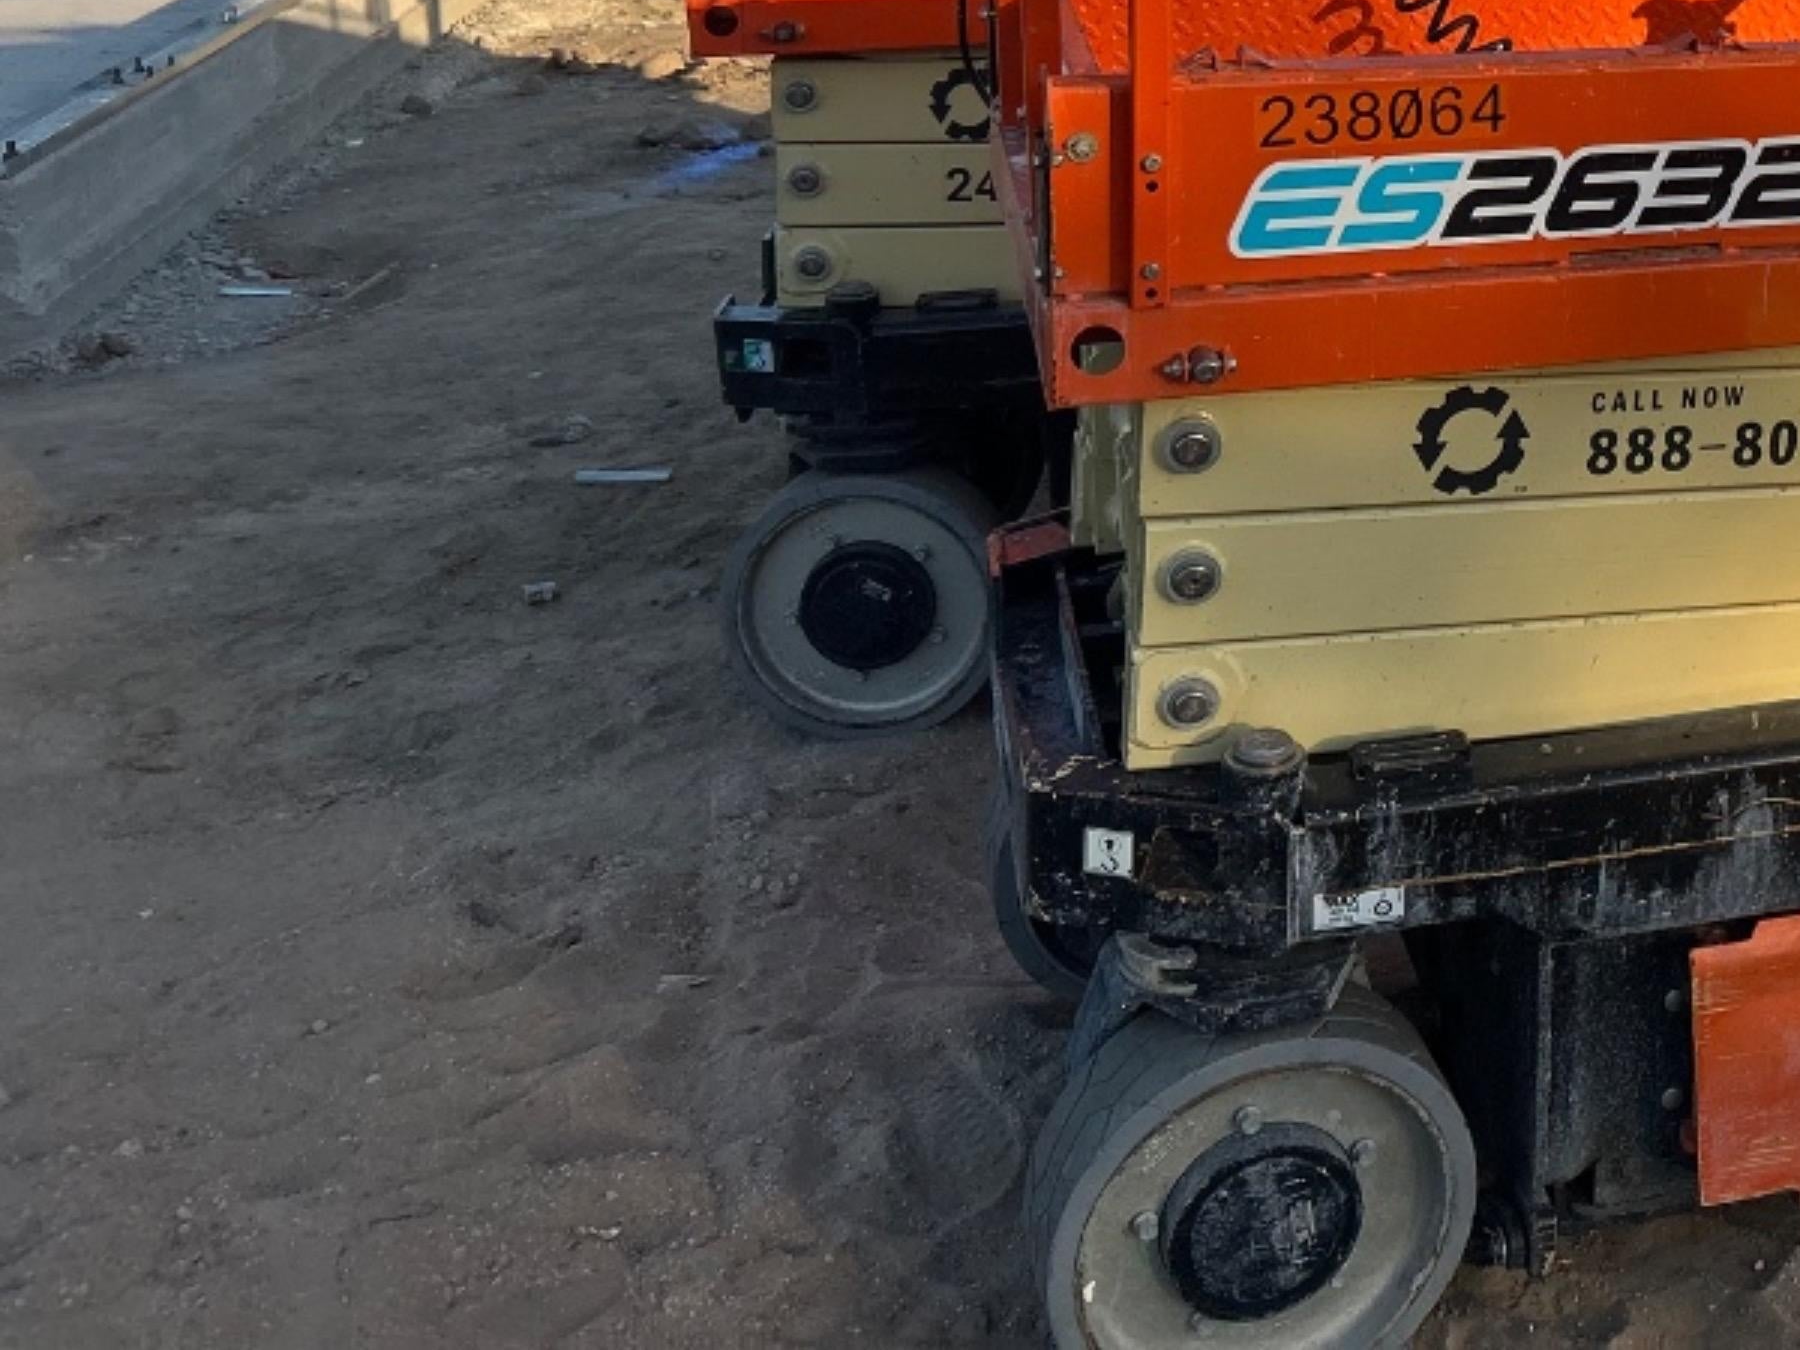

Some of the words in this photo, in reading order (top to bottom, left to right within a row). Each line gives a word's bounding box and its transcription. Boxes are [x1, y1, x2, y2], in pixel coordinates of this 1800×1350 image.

[1258, 82, 1506, 148] 238064
[1591, 388, 1664, 414] CALL
[1681, 385, 1745, 409] NOW
